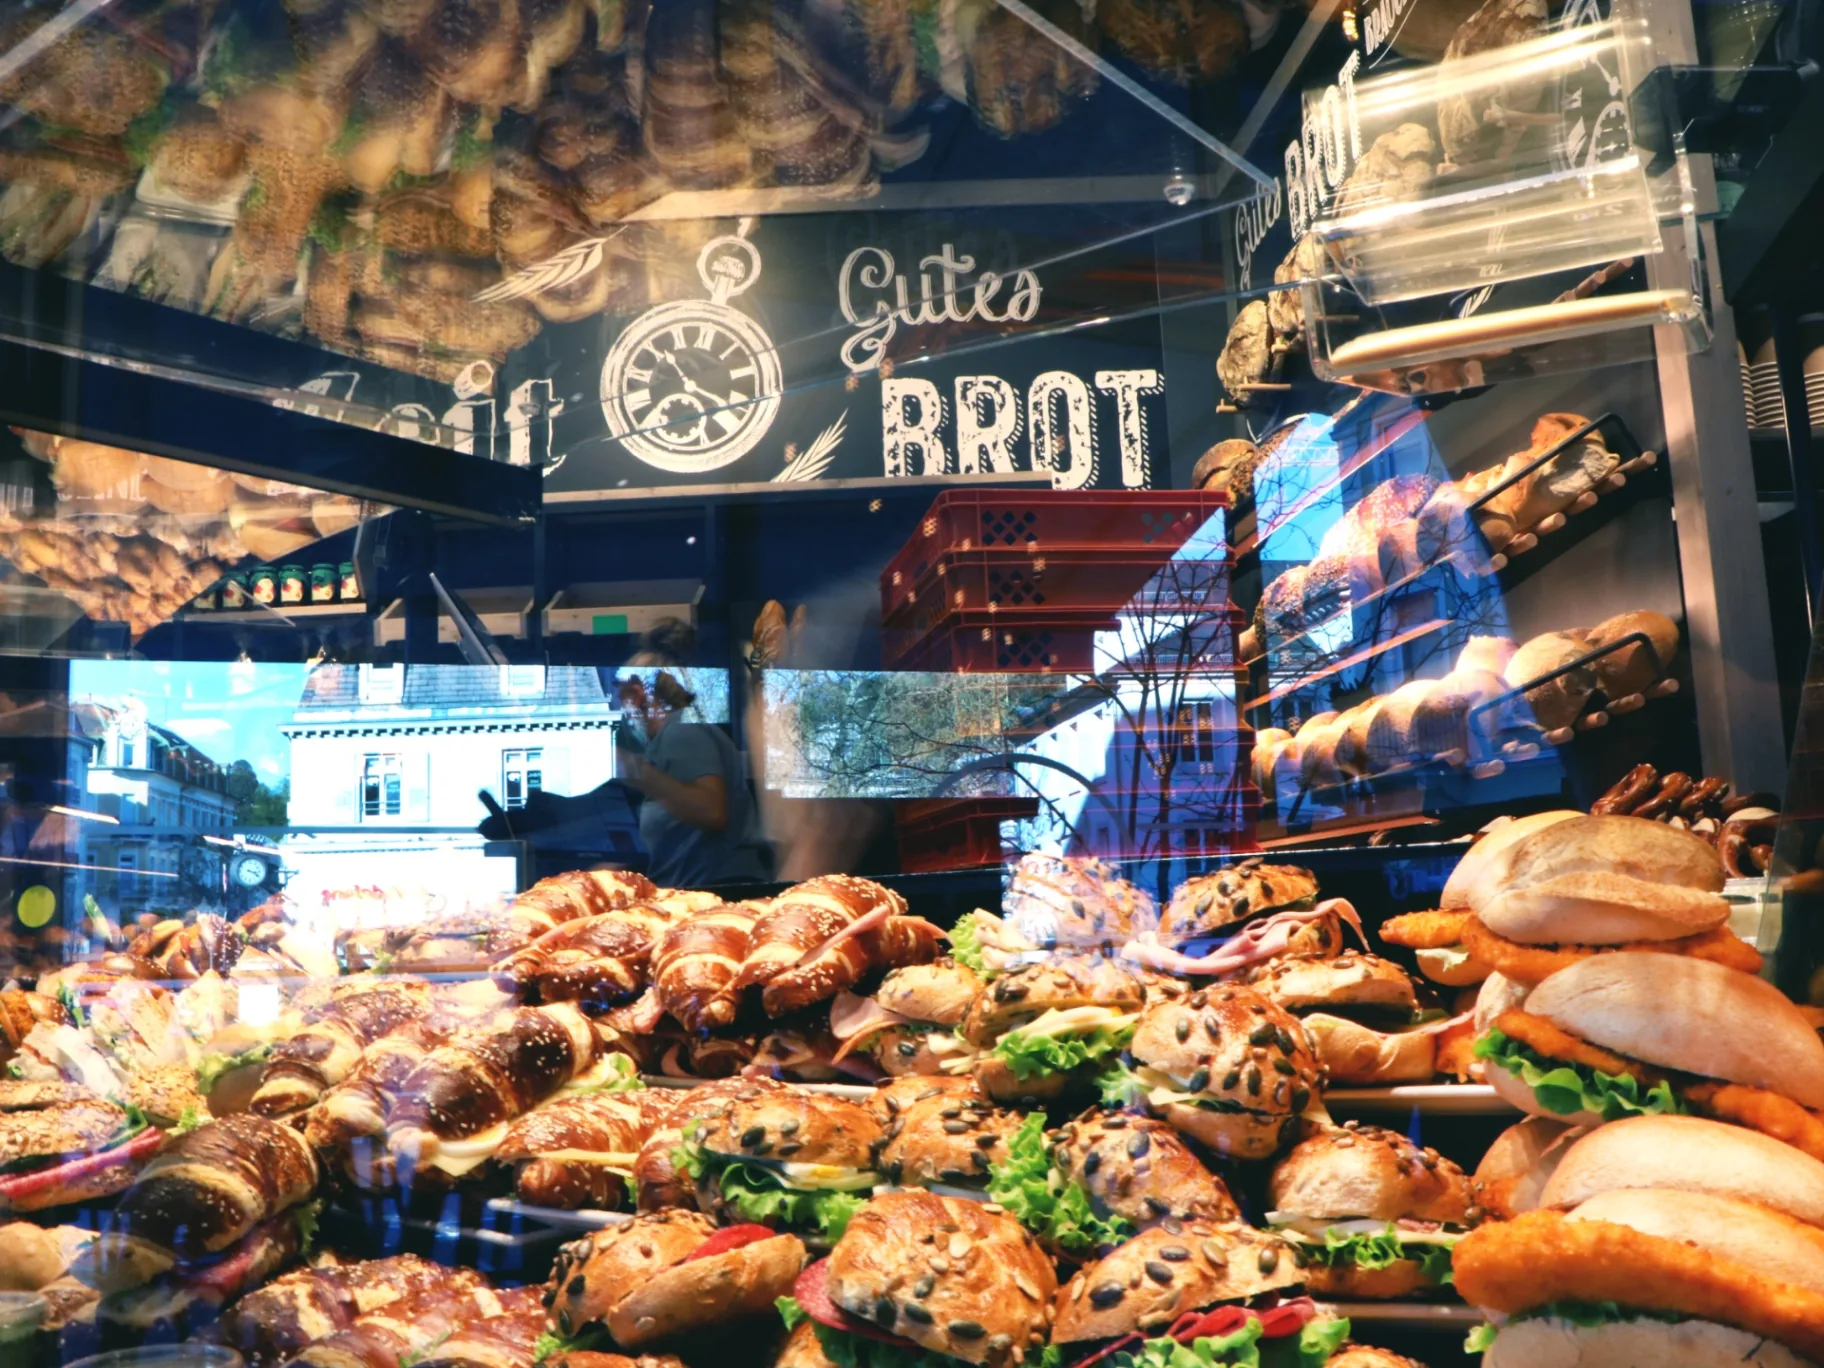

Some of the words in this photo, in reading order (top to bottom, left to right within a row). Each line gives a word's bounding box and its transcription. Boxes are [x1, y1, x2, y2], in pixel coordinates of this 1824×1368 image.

[1284, 49, 1363, 241] BROT
[838, 242, 1044, 372] Gutes
[882, 368, 1166, 491] BROT
